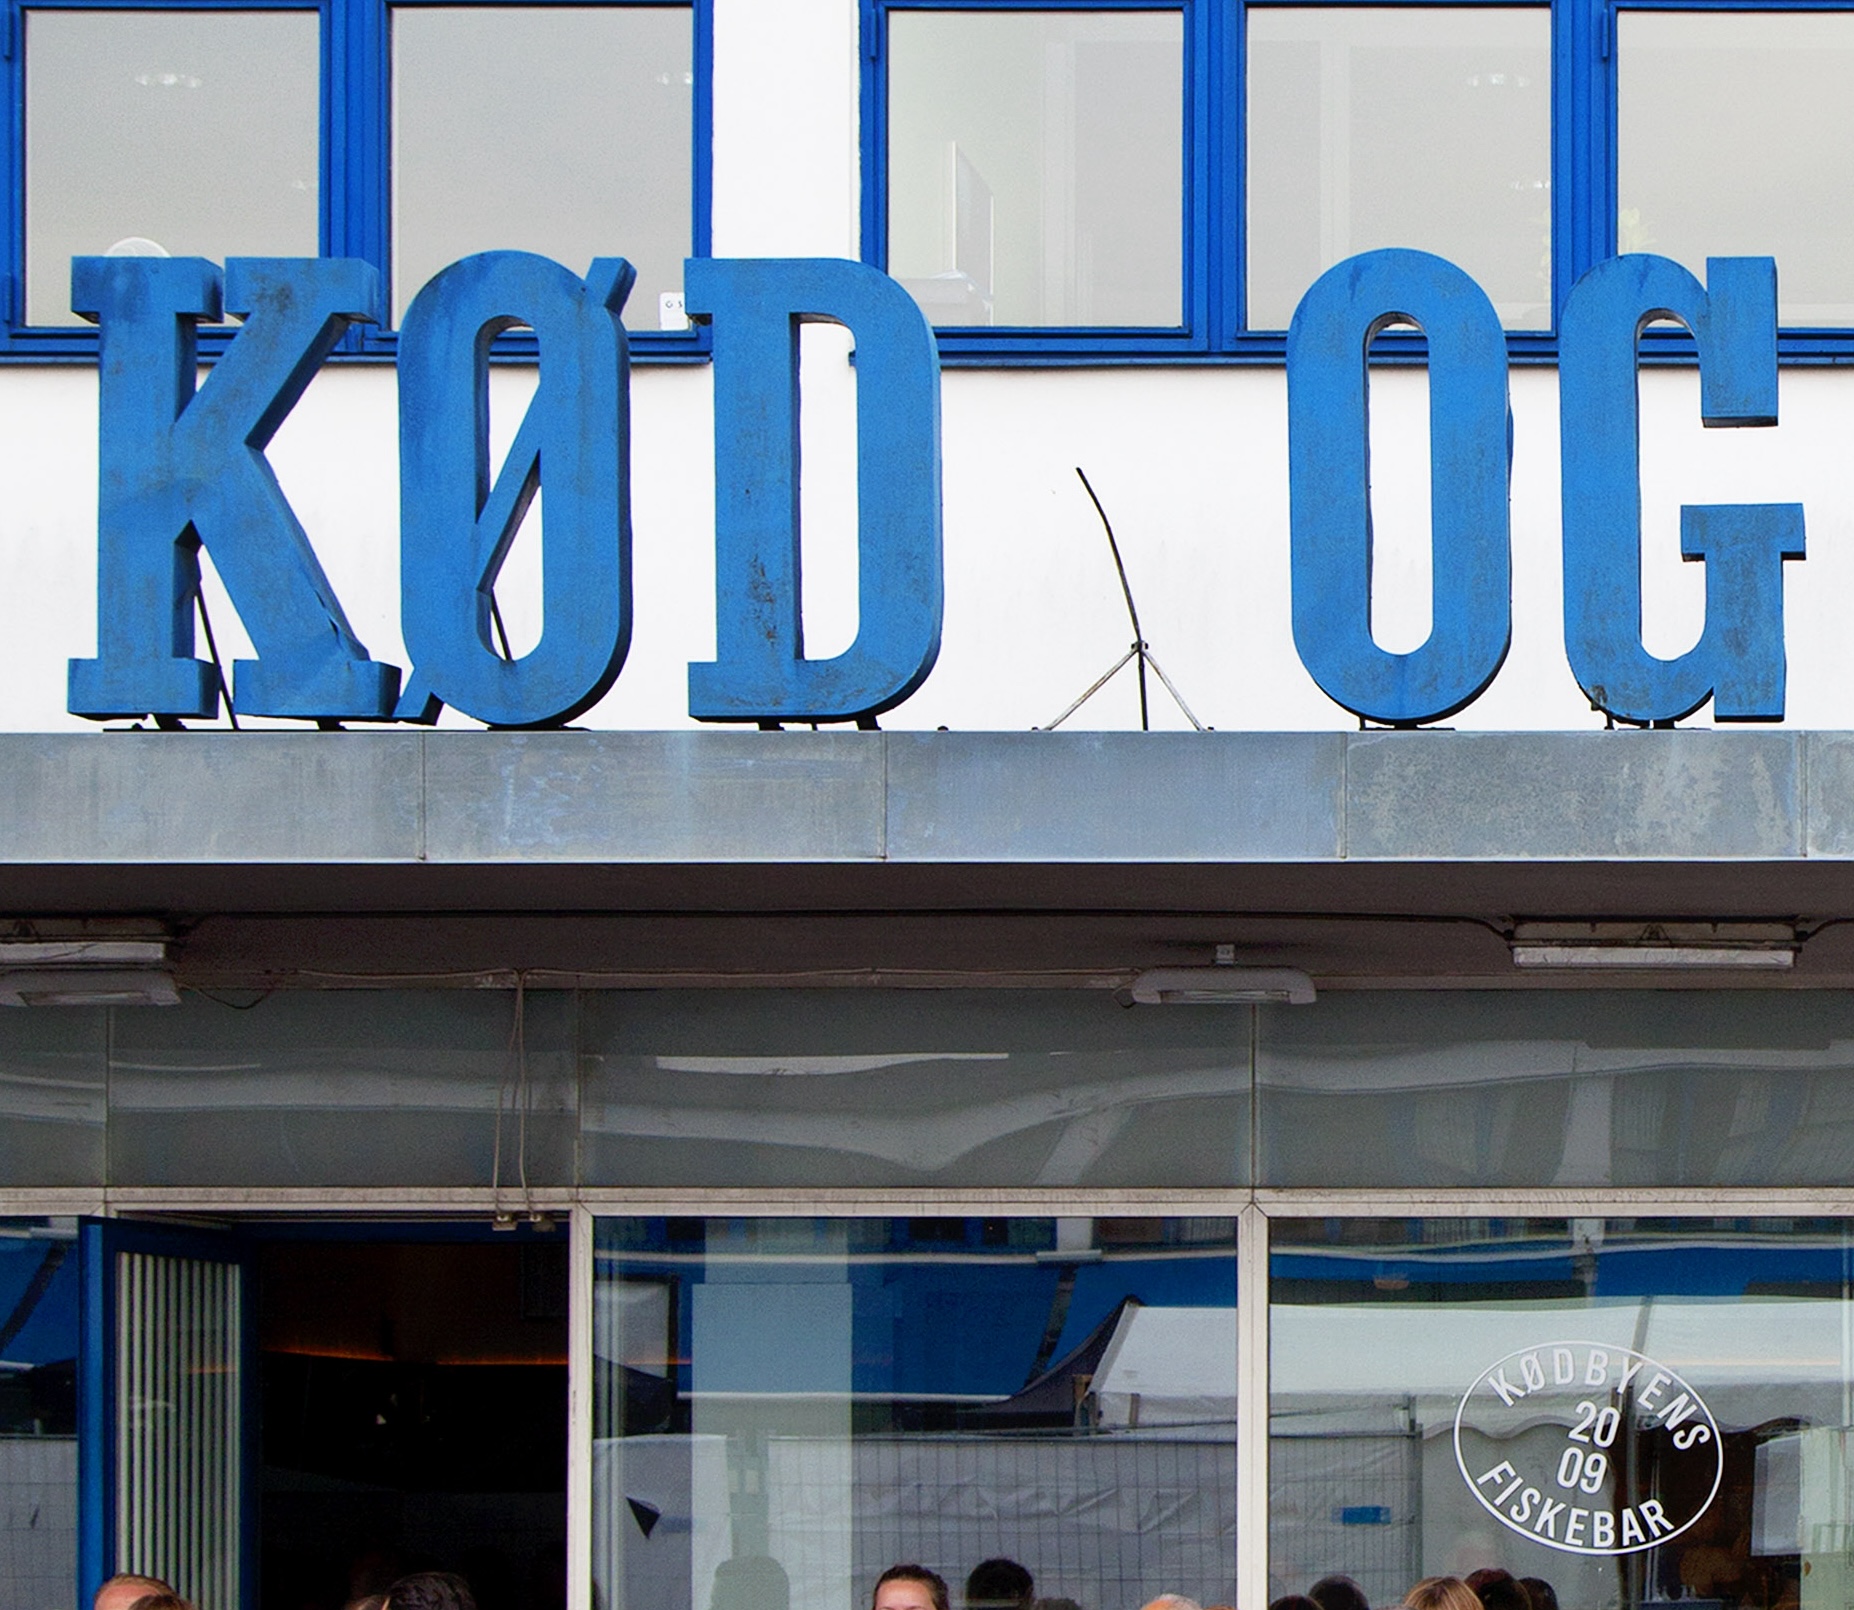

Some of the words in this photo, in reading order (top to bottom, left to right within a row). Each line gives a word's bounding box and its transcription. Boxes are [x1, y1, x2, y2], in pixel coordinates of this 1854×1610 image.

[67, 249, 945, 728] KØD
[1286, 247, 1807, 724] OG
[1486, 1346, 1711, 1452] KØDBYENS
[1567, 1400, 1621, 1449] 20
[1476, 1459, 1675, 1549] FISKEBAR
[1556, 1447, 1608, 1495] 09
